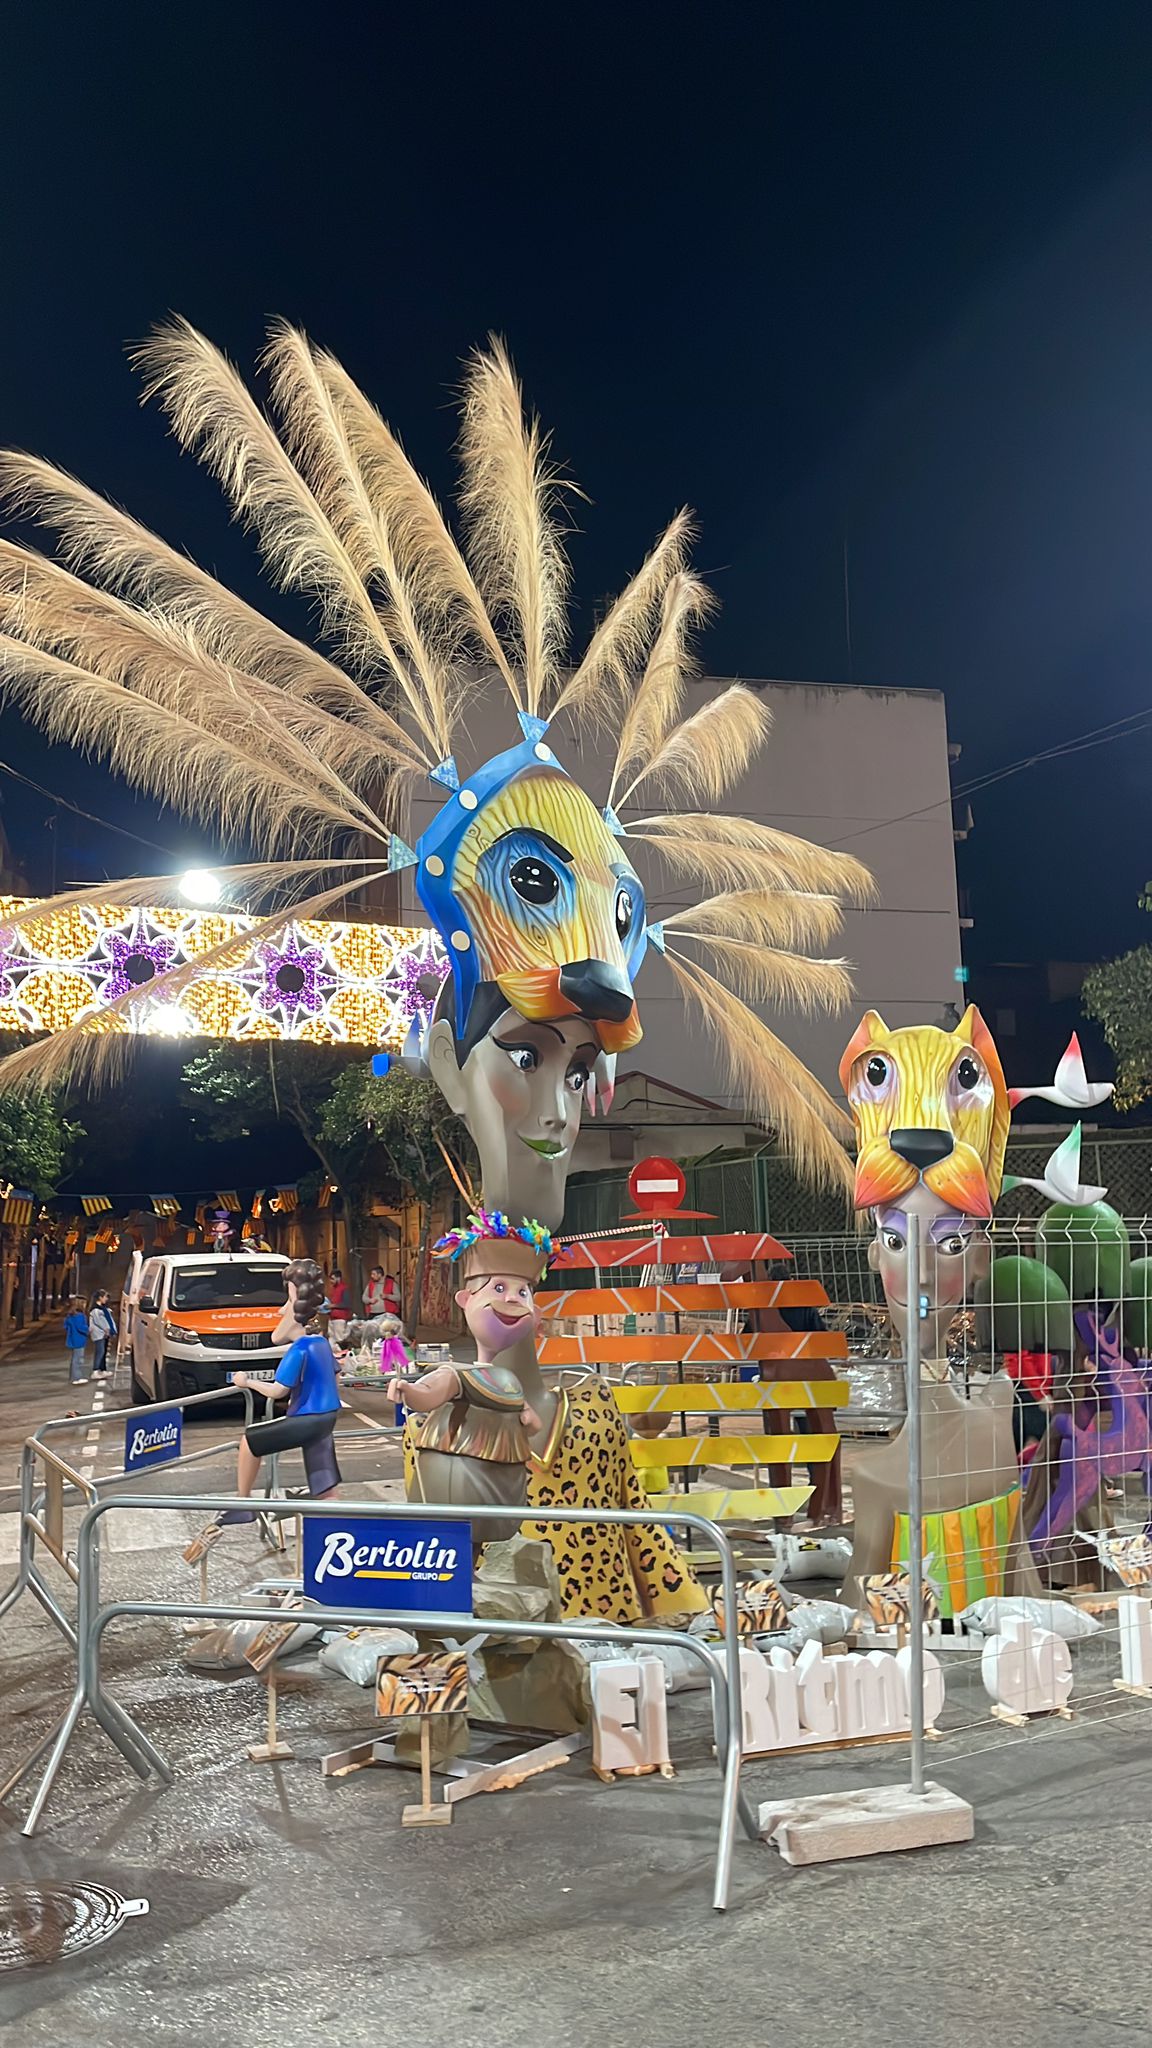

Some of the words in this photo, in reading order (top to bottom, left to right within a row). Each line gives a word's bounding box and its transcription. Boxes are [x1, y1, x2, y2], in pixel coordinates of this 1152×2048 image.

[241, 1333, 260, 1348] FIAT
[129, 1422, 178, 1461] Bertolín
[314, 1532, 458, 1584] Bertolín
[411, 1571, 438, 1581] GRUPO
